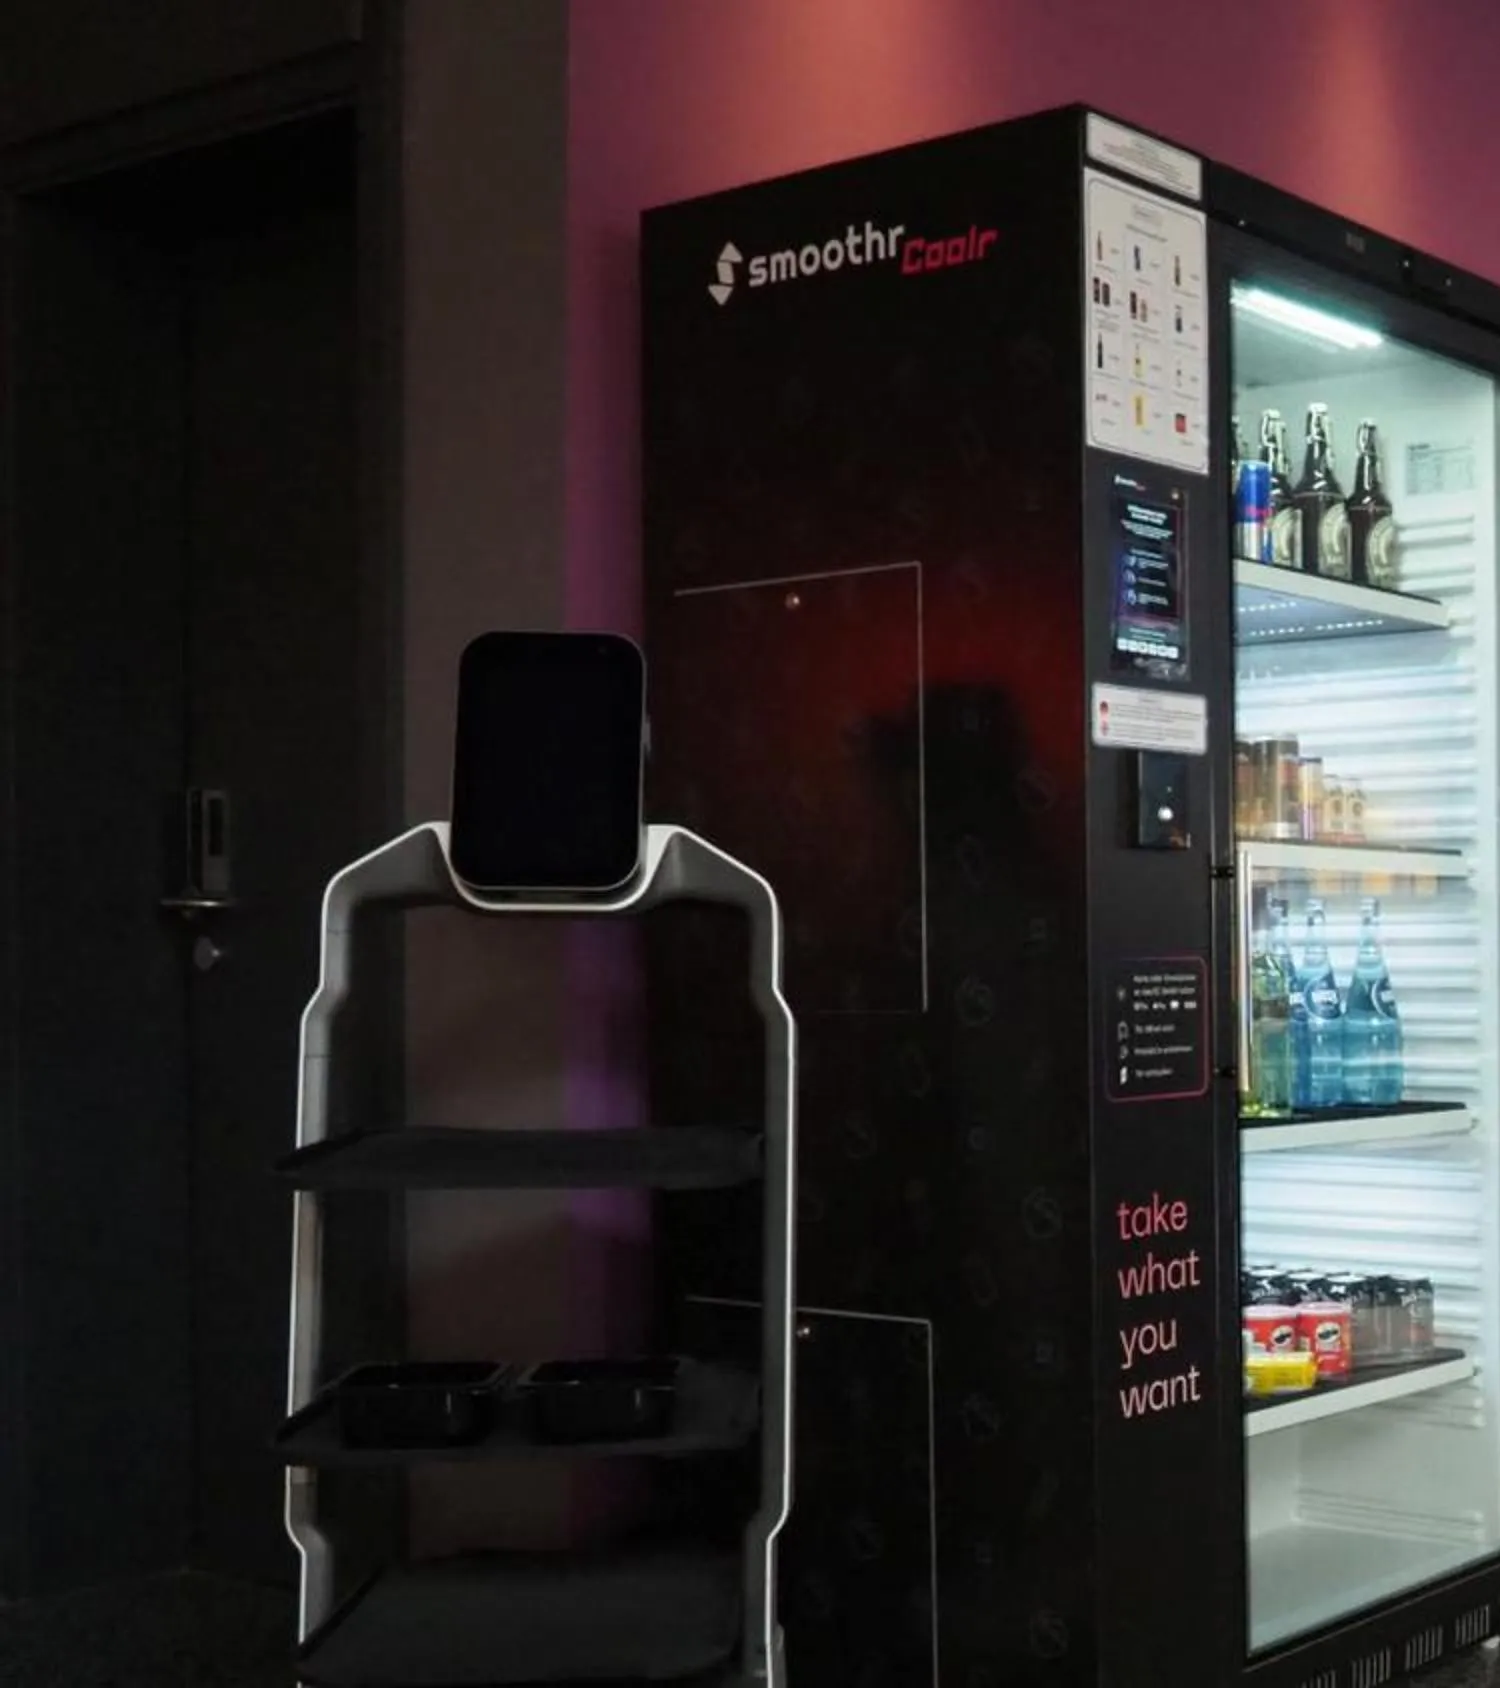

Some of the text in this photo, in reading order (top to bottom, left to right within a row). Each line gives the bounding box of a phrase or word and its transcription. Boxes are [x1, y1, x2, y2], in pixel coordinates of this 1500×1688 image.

[748, 221, 998, 287] smoothr Coolr
[1117, 1192, 1188, 1241] take
[1117, 1250, 1200, 1299] what
[1120, 1319, 1177, 1370] you
[1119, 1365, 1201, 1419] want
